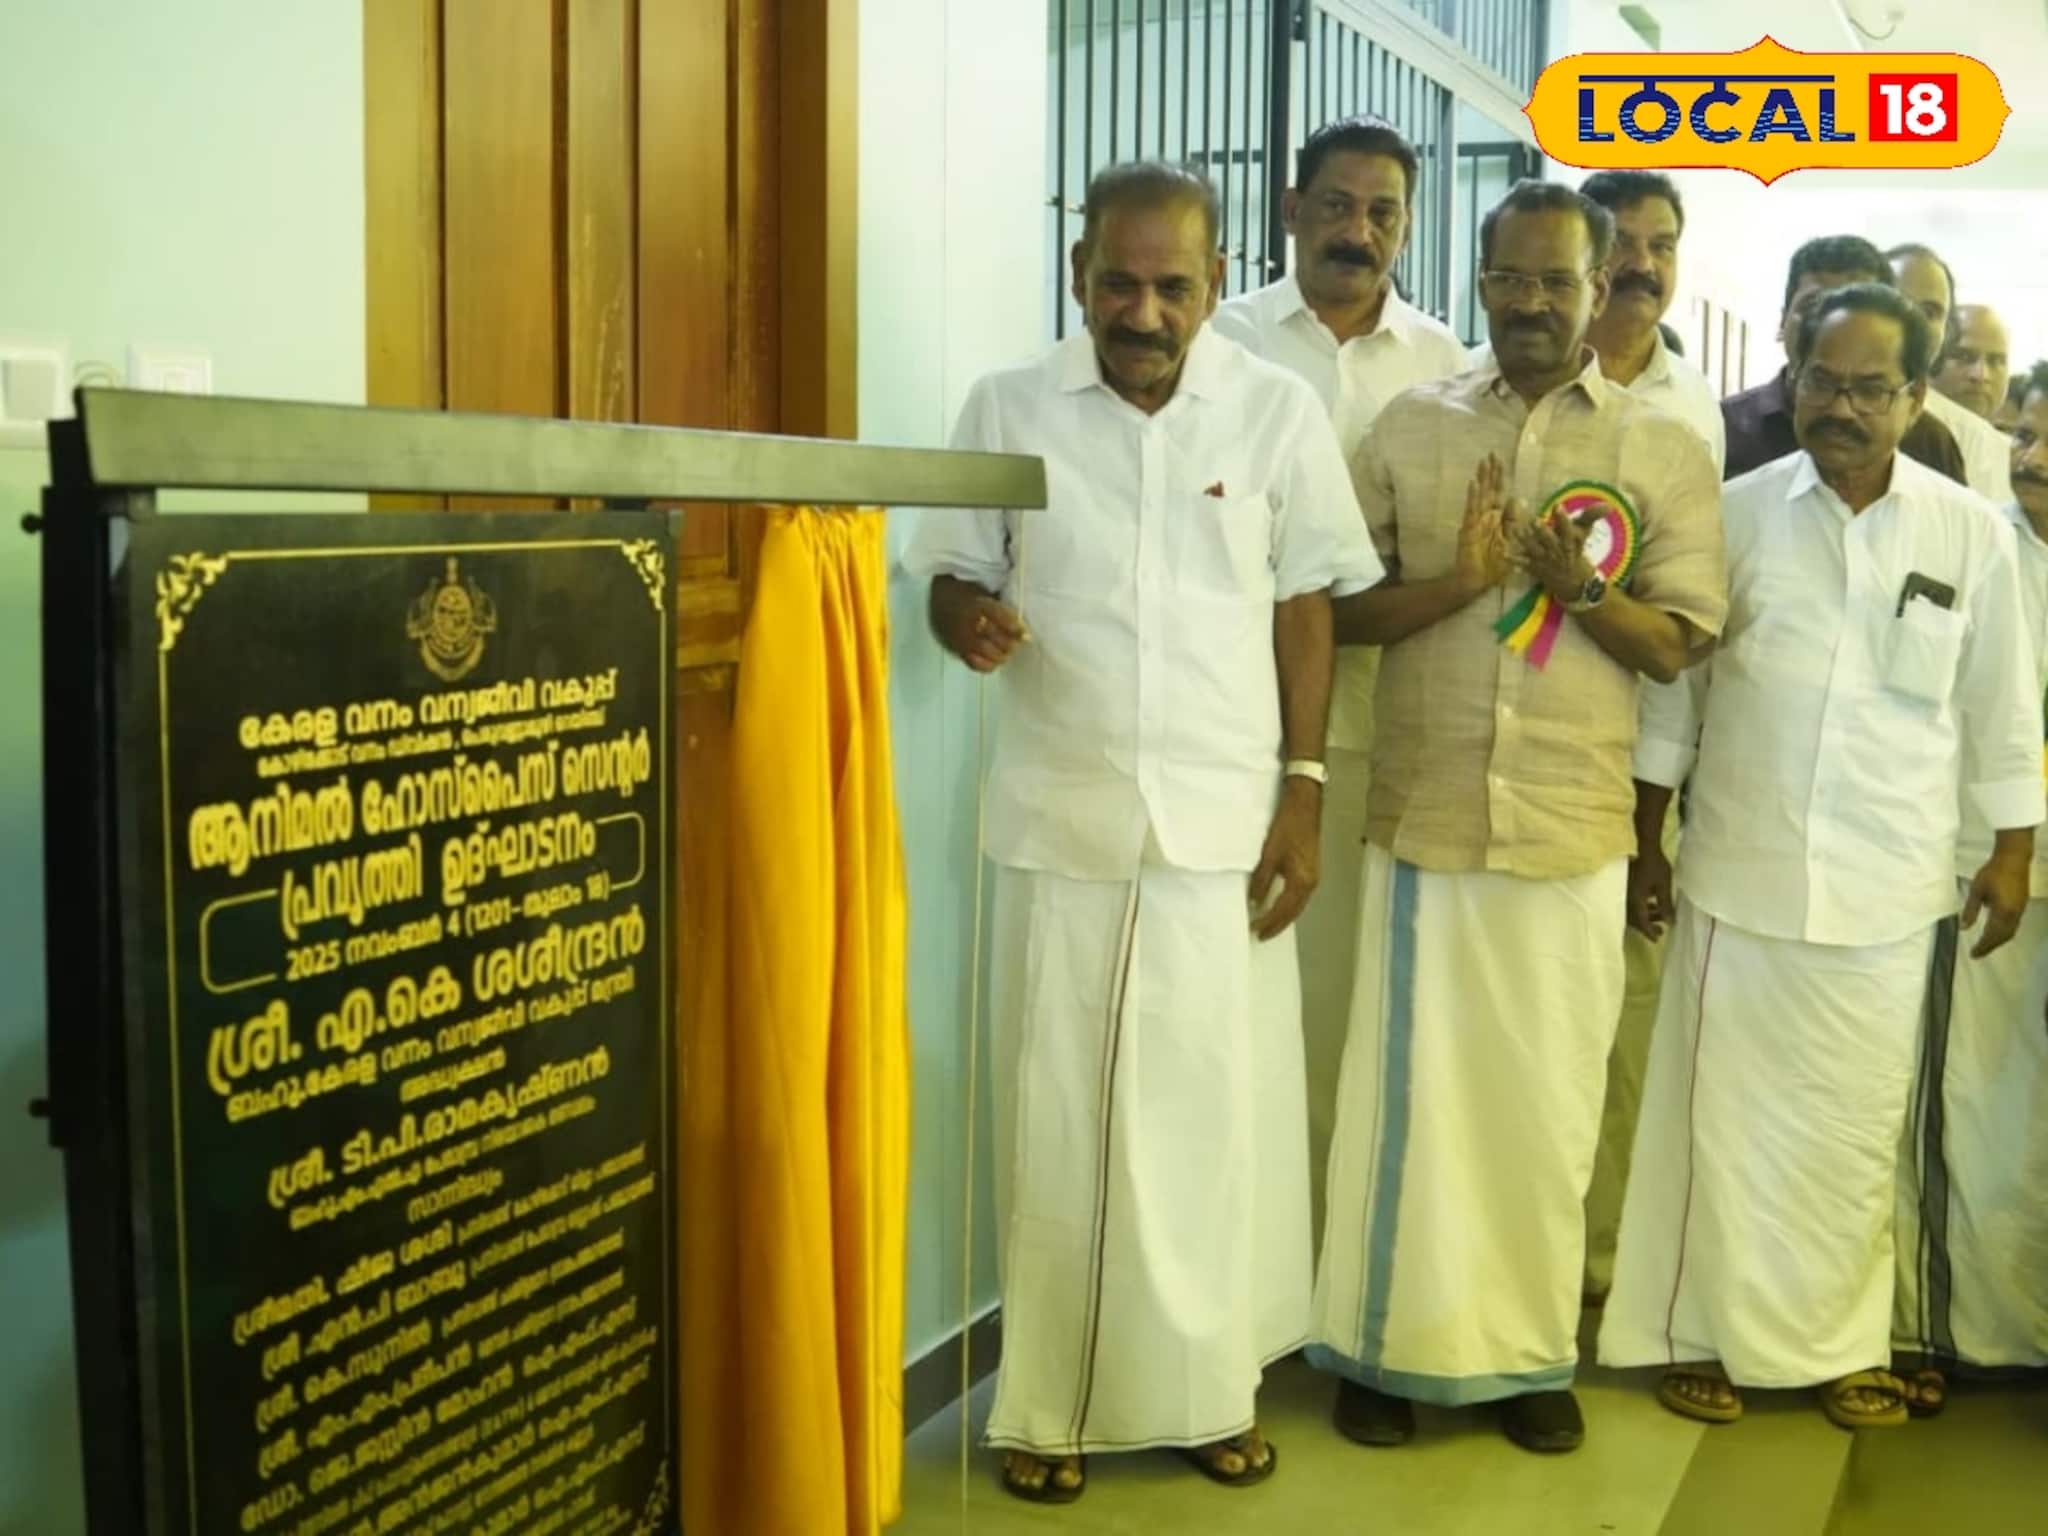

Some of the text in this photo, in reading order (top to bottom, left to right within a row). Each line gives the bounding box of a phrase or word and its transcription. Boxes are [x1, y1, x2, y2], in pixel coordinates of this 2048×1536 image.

[239, 707, 338, 748] കേരള
[345, 700, 413, 735] വനം
[419, 677, 536, 724] വന്യജീവി
[540, 667, 618, 708] വകുപ്പ്
[188, 775, 354, 877] ആനിമൽ
[361, 741, 559, 836] ഹോസ്പൈസ്
[441, 820, 597, 907] ഉദ്ഘാടനം
[286, 939, 341, 982] 2025
[446, 908, 461, 938] 4
[208, 903, 646, 1096] ശ്രീ. എ.കെ ശശീന്ദ്രൻ
[381, 1037, 433, 1073] വനം
[267, 1147, 335, 1209] ശ്രീ.
